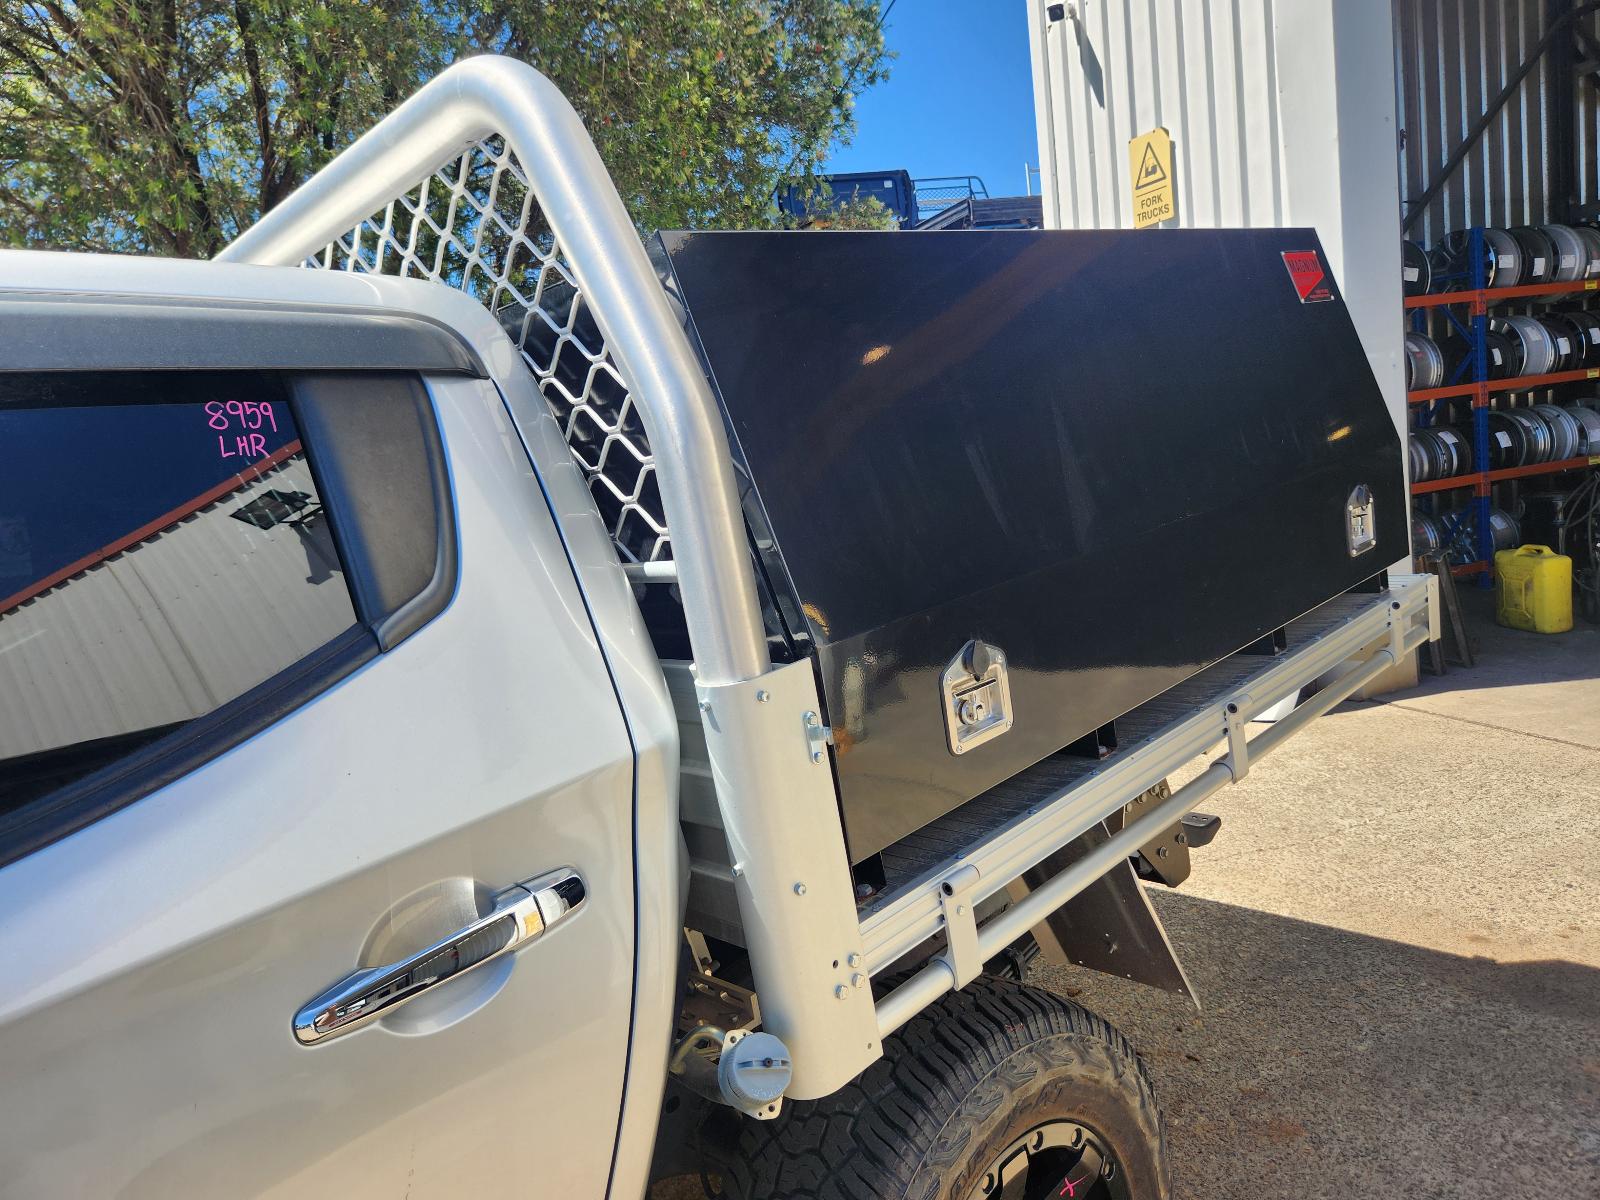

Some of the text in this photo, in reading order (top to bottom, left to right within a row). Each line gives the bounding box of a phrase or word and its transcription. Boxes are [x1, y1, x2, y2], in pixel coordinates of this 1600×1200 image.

[1137, 203, 1170, 222] TRUCKS
[1140, 194, 1163, 209] FORK
[204, 400, 278, 432] 8959
[219, 433, 271, 458] LHR
